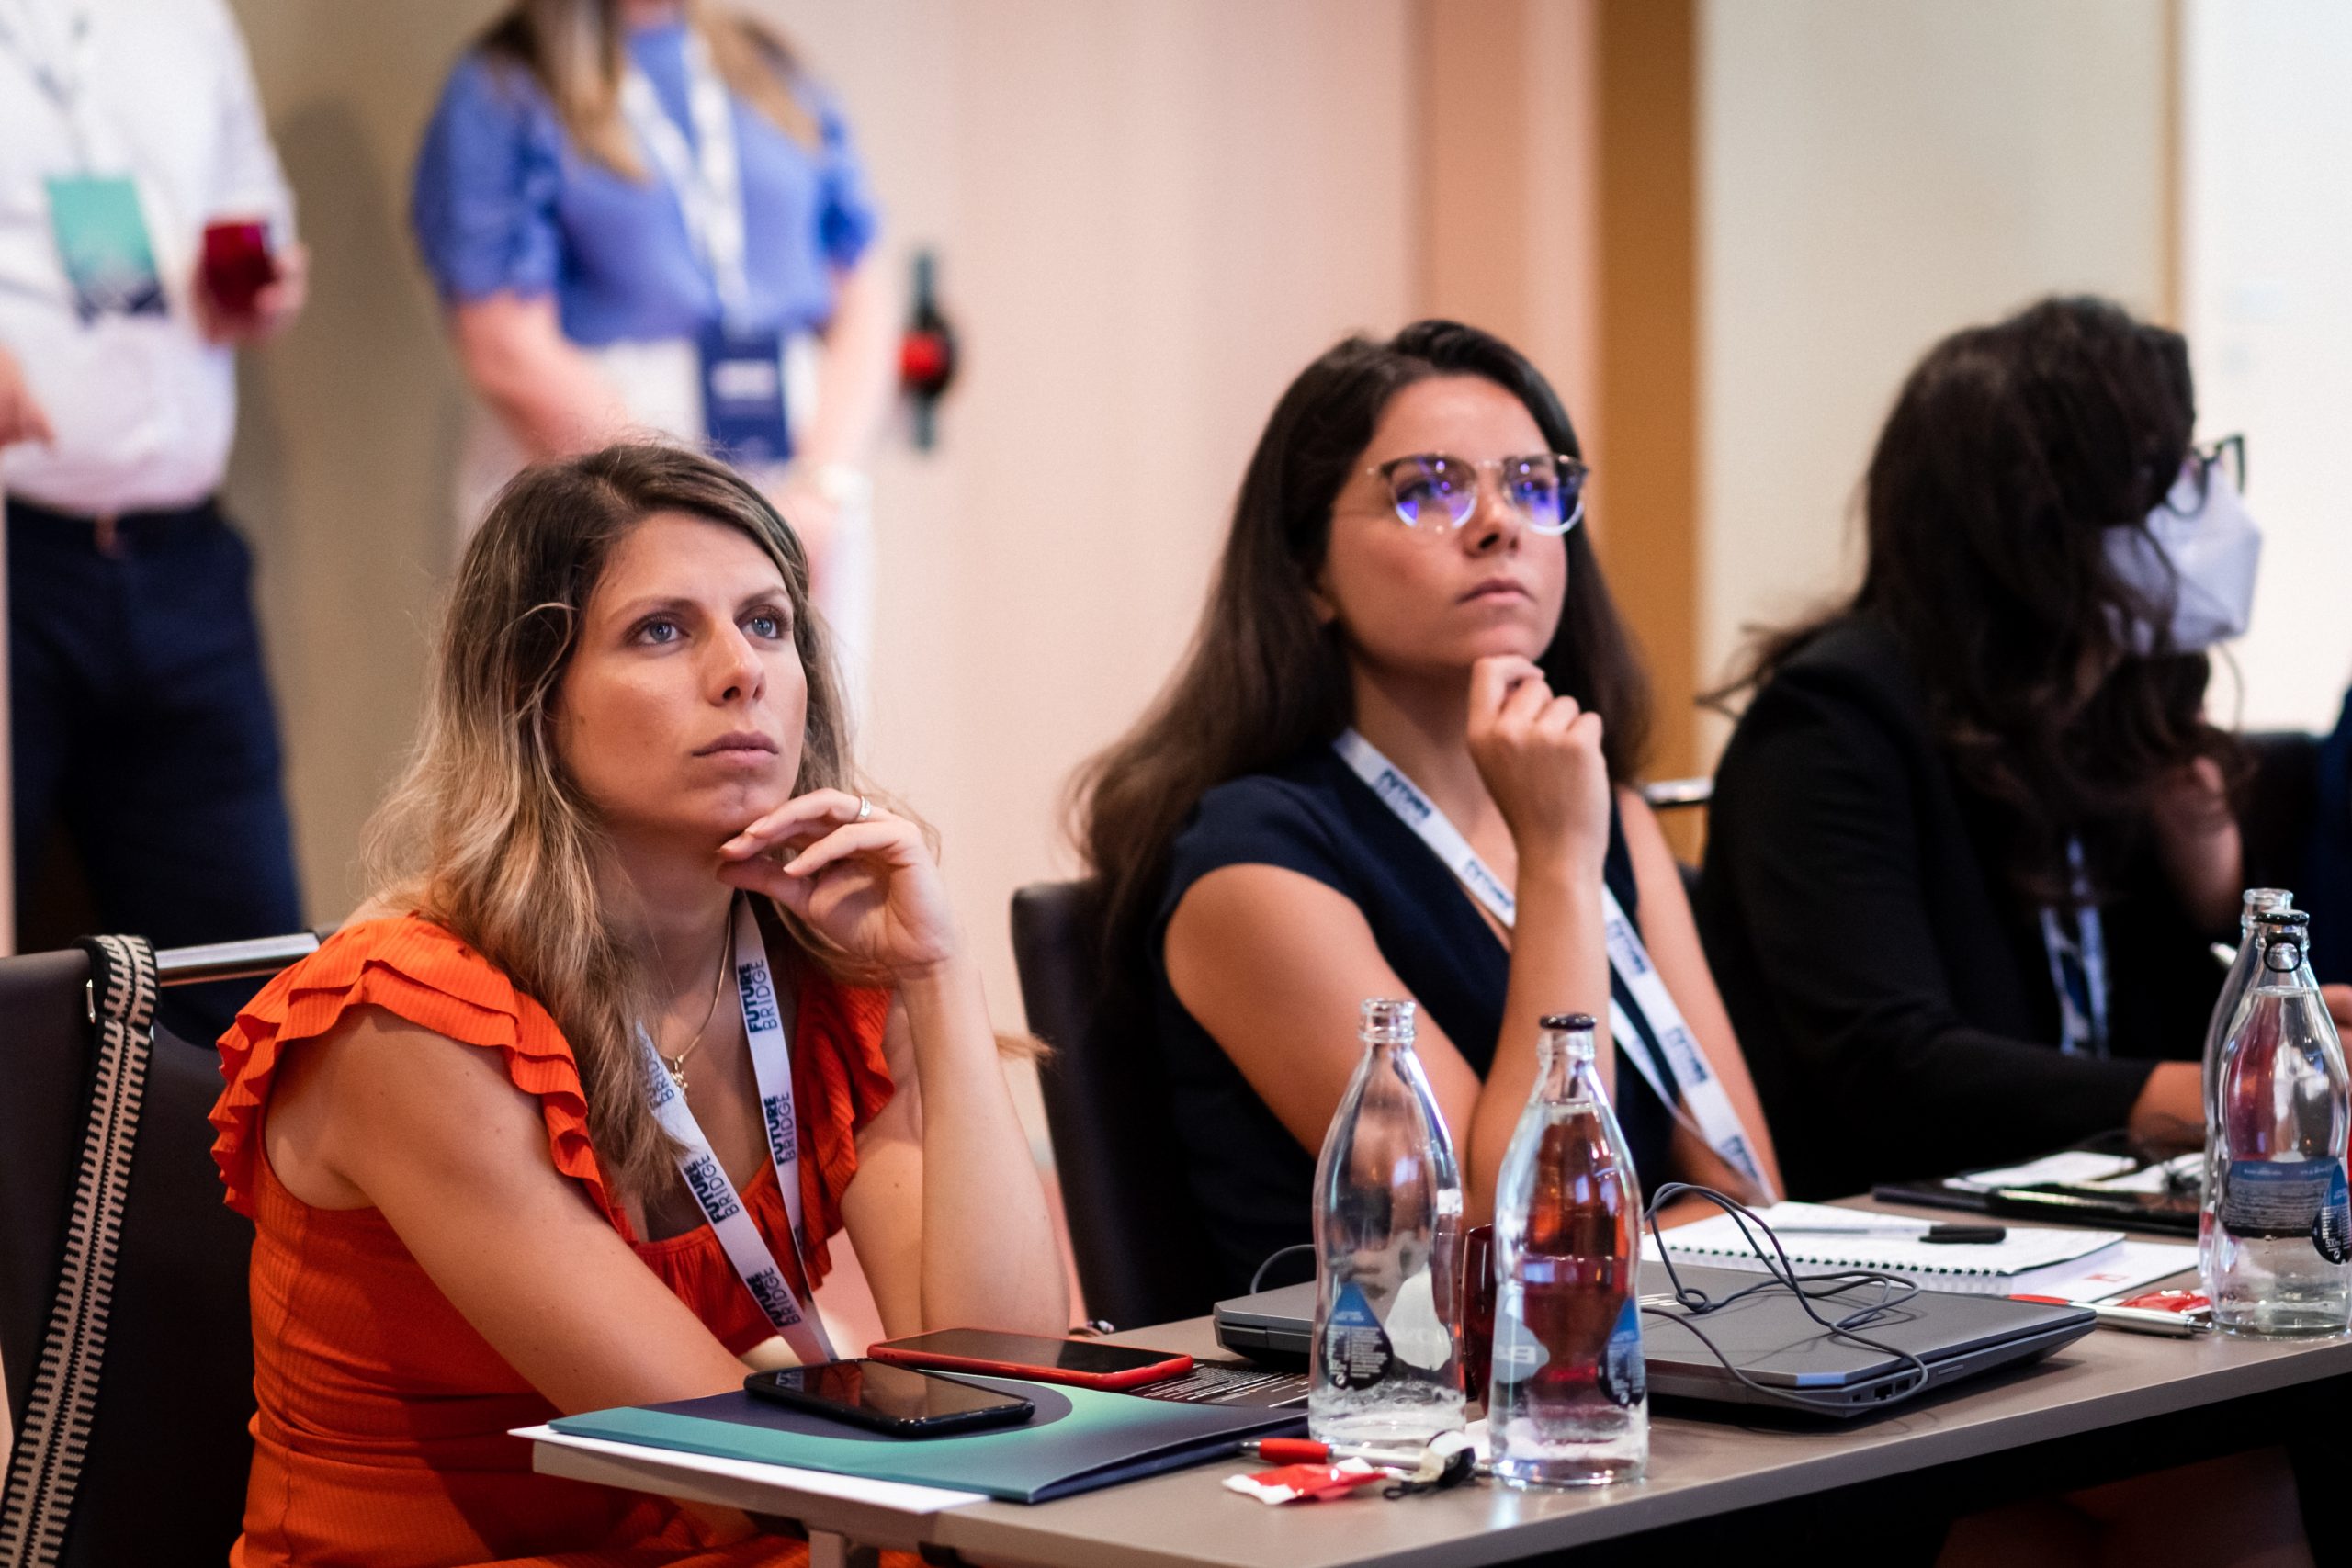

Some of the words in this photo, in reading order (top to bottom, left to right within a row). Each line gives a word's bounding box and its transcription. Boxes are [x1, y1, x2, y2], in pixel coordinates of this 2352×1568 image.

[739, 963, 763, 1033] FUTURE
[751, 959, 777, 1031] BRIDGE
[764, 1096, 786, 1166] FUTURE
[776, 1092, 796, 1162] BRIDGE
[684, 1161, 727, 1224] FUTURE
[696, 1153, 740, 1217] BRIDGE
[746, 1272, 790, 1328] FUTURE
[759, 1267, 802, 1325] BRIDGE
